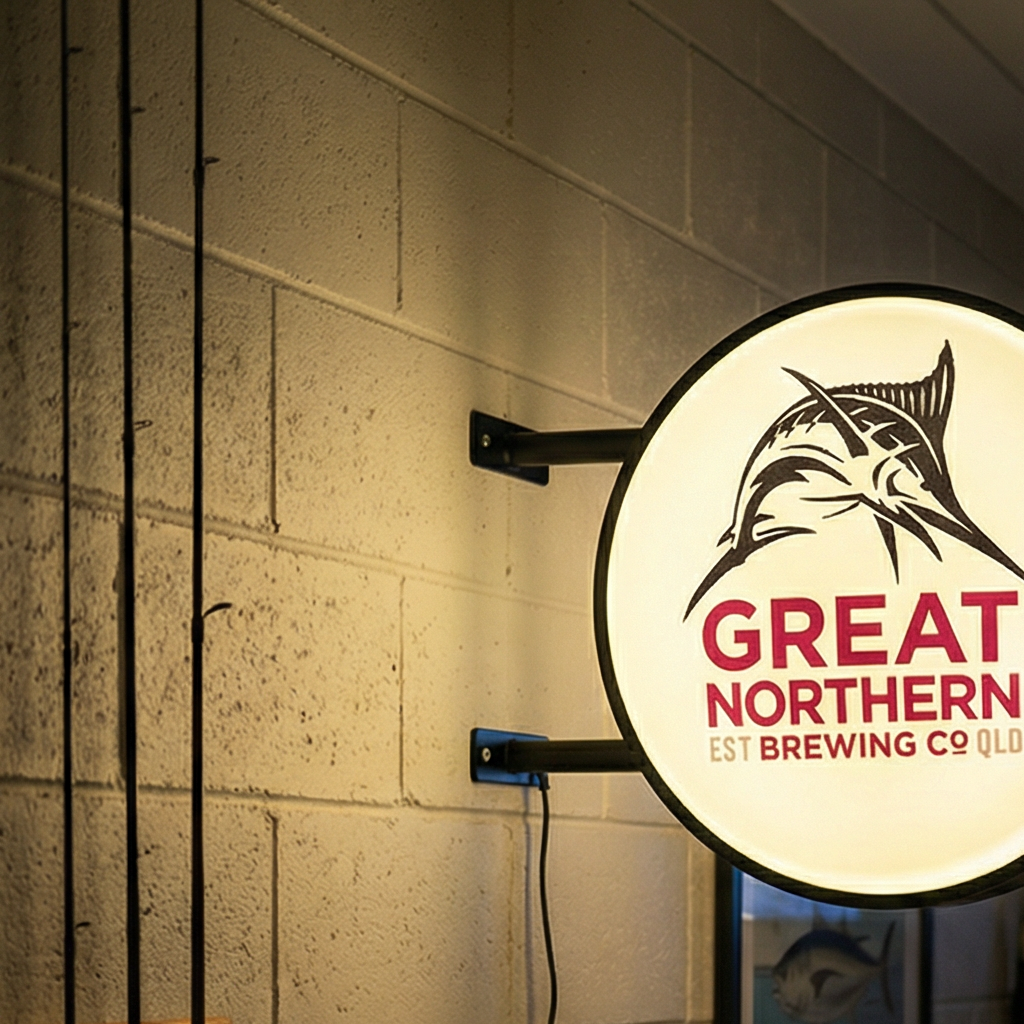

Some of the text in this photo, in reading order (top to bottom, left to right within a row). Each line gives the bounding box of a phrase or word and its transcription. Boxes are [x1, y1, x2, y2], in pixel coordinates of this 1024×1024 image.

[702, 590, 1019, 671] GREAT
[706, 673, 1021, 728] NORTHERN
[709, 735, 752, 762] EST
[760, 731, 917, 761] BREWING
[976, 728, 1023, 758] QLD
